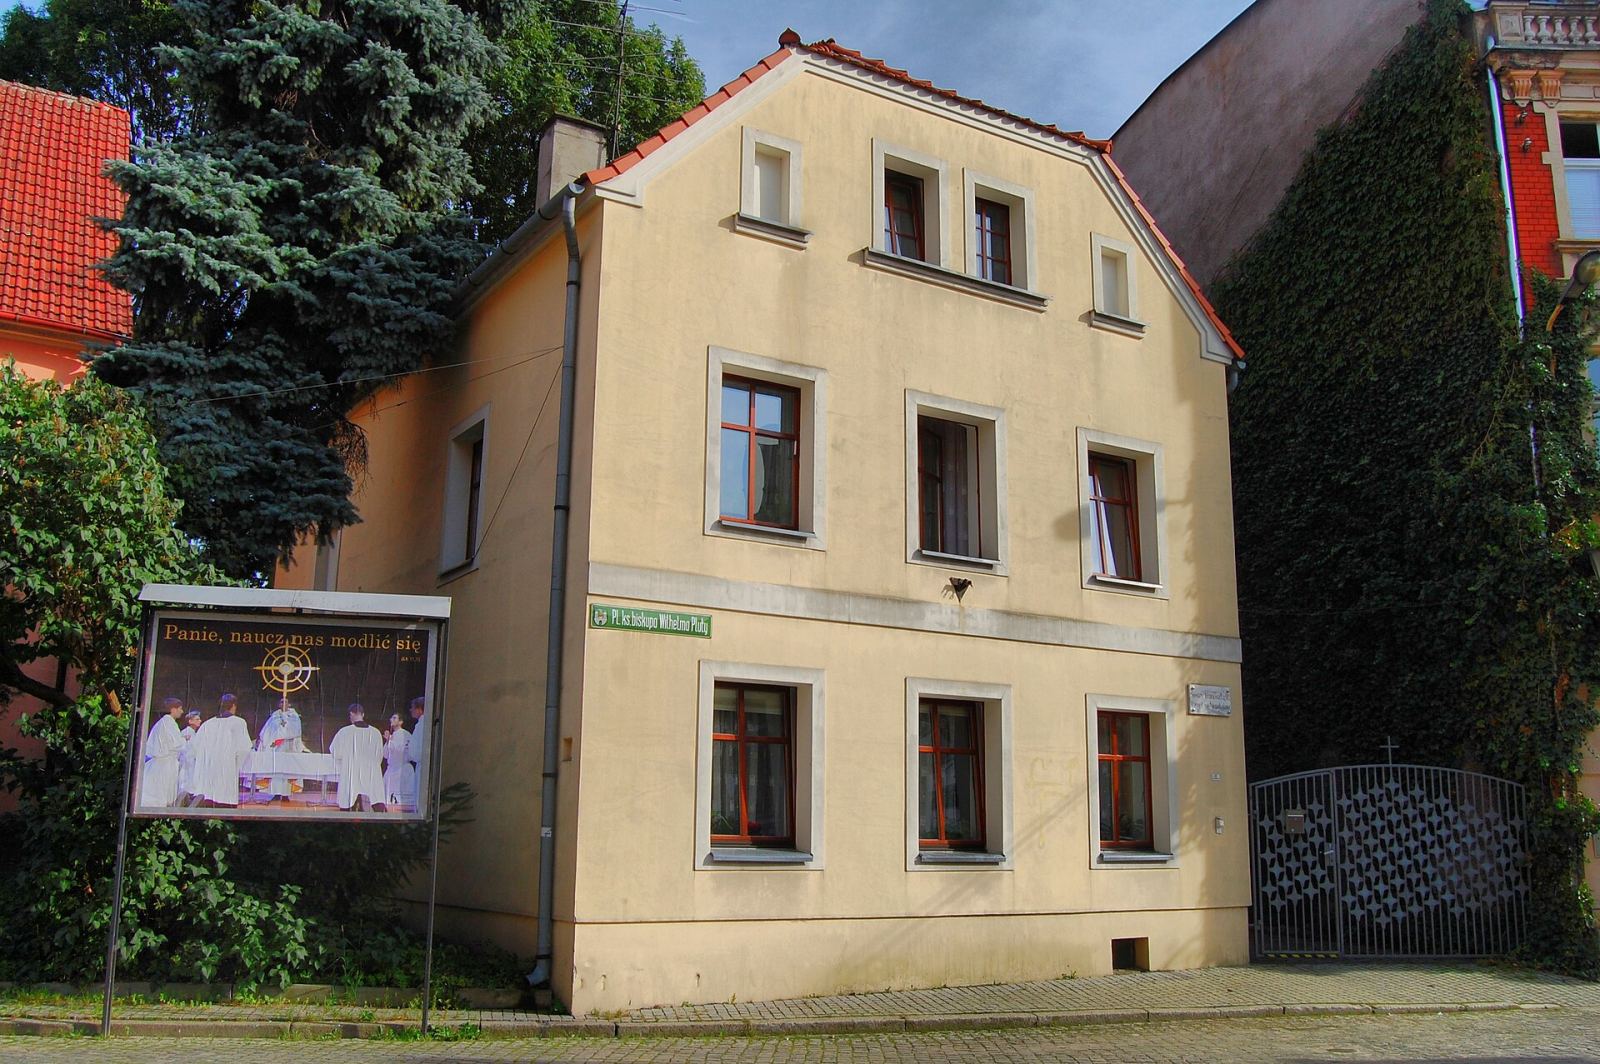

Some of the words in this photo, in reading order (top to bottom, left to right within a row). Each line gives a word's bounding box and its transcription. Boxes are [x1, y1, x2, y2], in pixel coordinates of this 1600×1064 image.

[659, 612, 690, 632] Wilhelma
[690, 616, 709, 636] Pluty
[164, 624, 223, 645] Panie,
[230, 631, 284, 645] naucz
[291, 634, 325, 646] nas
[330, 633, 390, 649] modlić
[396, 635, 421, 653] się
